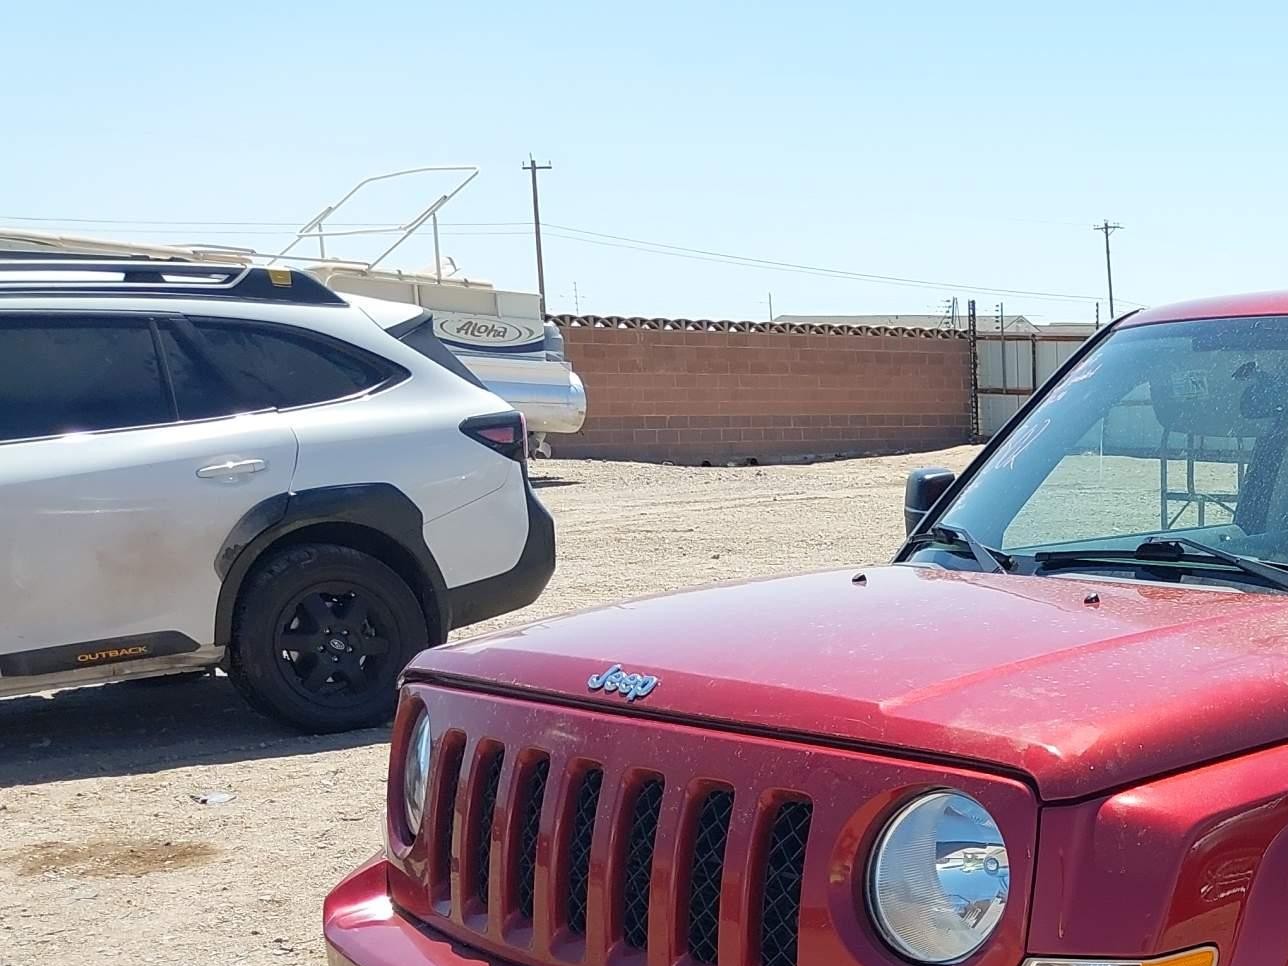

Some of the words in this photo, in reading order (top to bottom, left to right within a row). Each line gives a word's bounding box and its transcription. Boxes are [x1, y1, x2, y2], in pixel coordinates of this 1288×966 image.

[456, 320, 508, 339] Aloha
[77, 645, 149, 662] OUTBACK
[588, 664, 658, 701] Jeep
